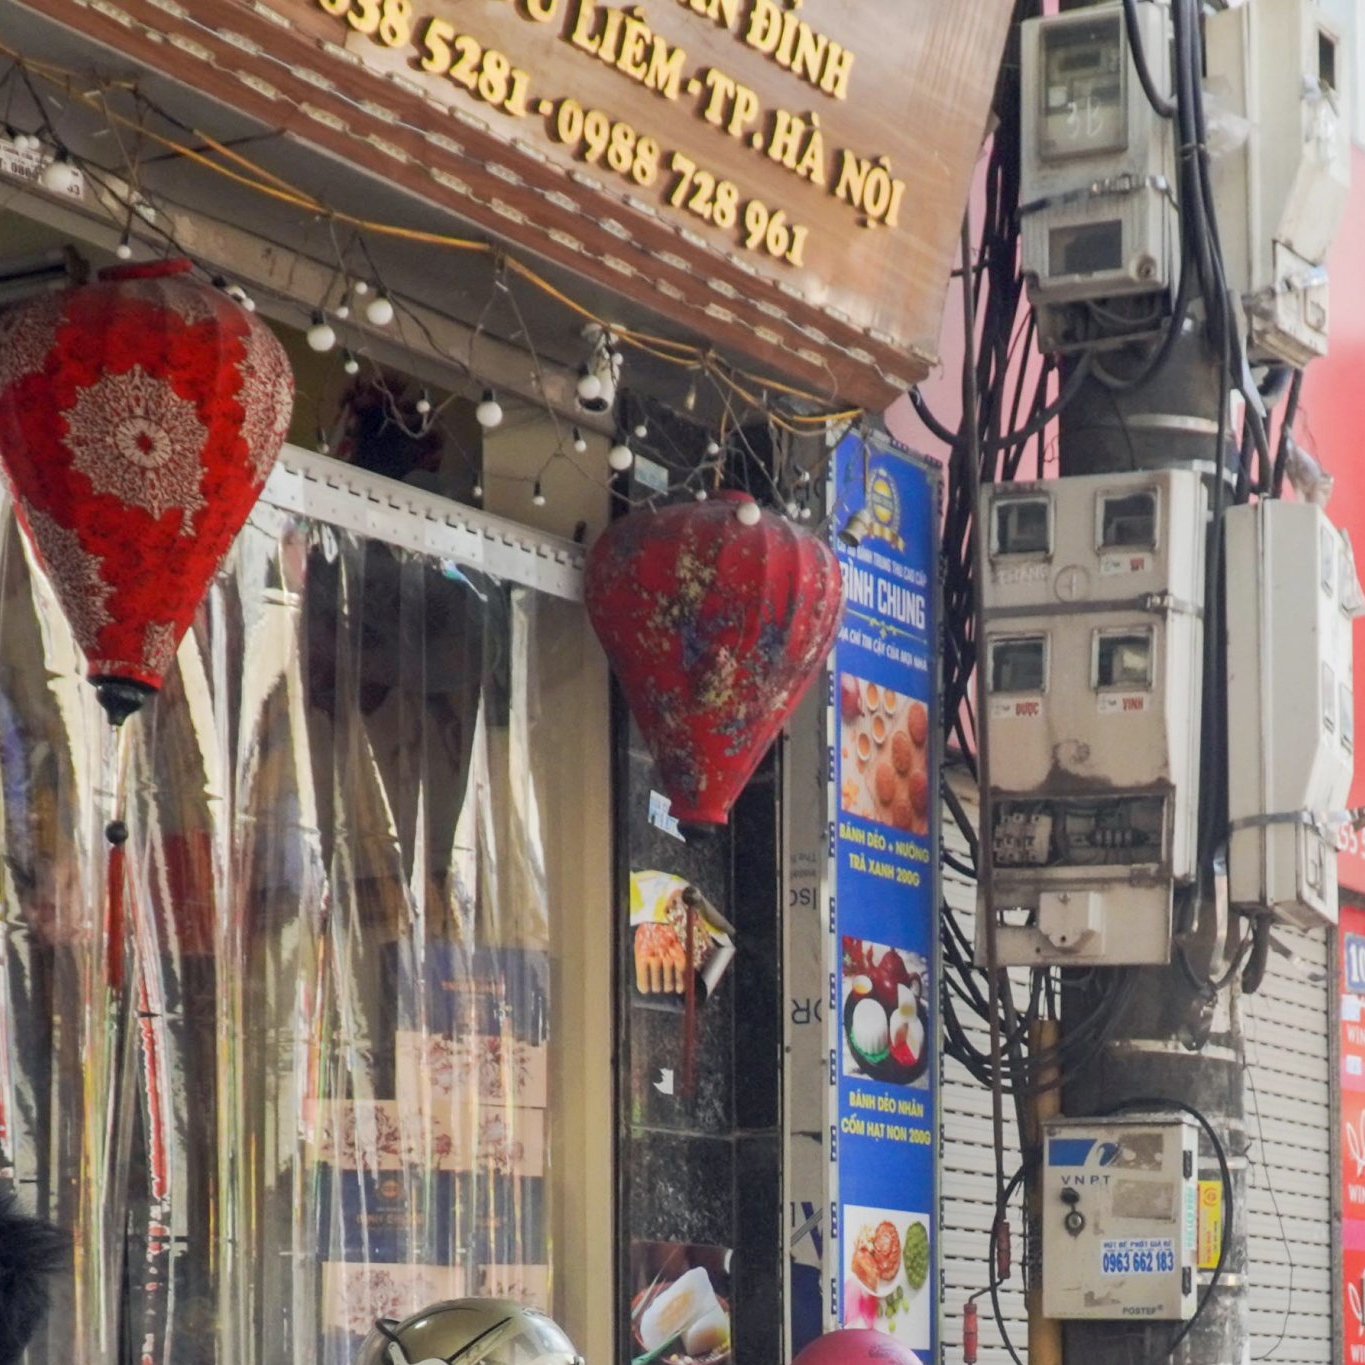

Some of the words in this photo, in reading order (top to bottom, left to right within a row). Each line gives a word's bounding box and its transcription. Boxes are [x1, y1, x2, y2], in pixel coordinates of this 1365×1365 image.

[421, 19, 530, 118] 5281
[557, 98, 661, 188] 0988
[669, 150, 737, 230] 728
[744, 199, 808, 268] 961
[837, 148, 905, 229] NỘI
[839, 556, 874, 609] BÌNH
[877, 577, 926, 630] CHUNG
[839, 820, 866, 846] BÁNH
[848, 851, 866, 873] TRÀ
[867, 857, 895, 880] XANH
[848, 1087, 876, 1110] BÁNH
[841, 1113, 865, 1136] CỐM
[866, 1120, 885, 1142] HẠT
[886, 1124, 907, 1141] NON
[1061, 1174, 1112, 1186] VNPT
[1102, 1252, 1130, 1274] 0963
[1134, 1252, 1153, 1273] 662
[1155, 1251, 1174, 1272] 183
